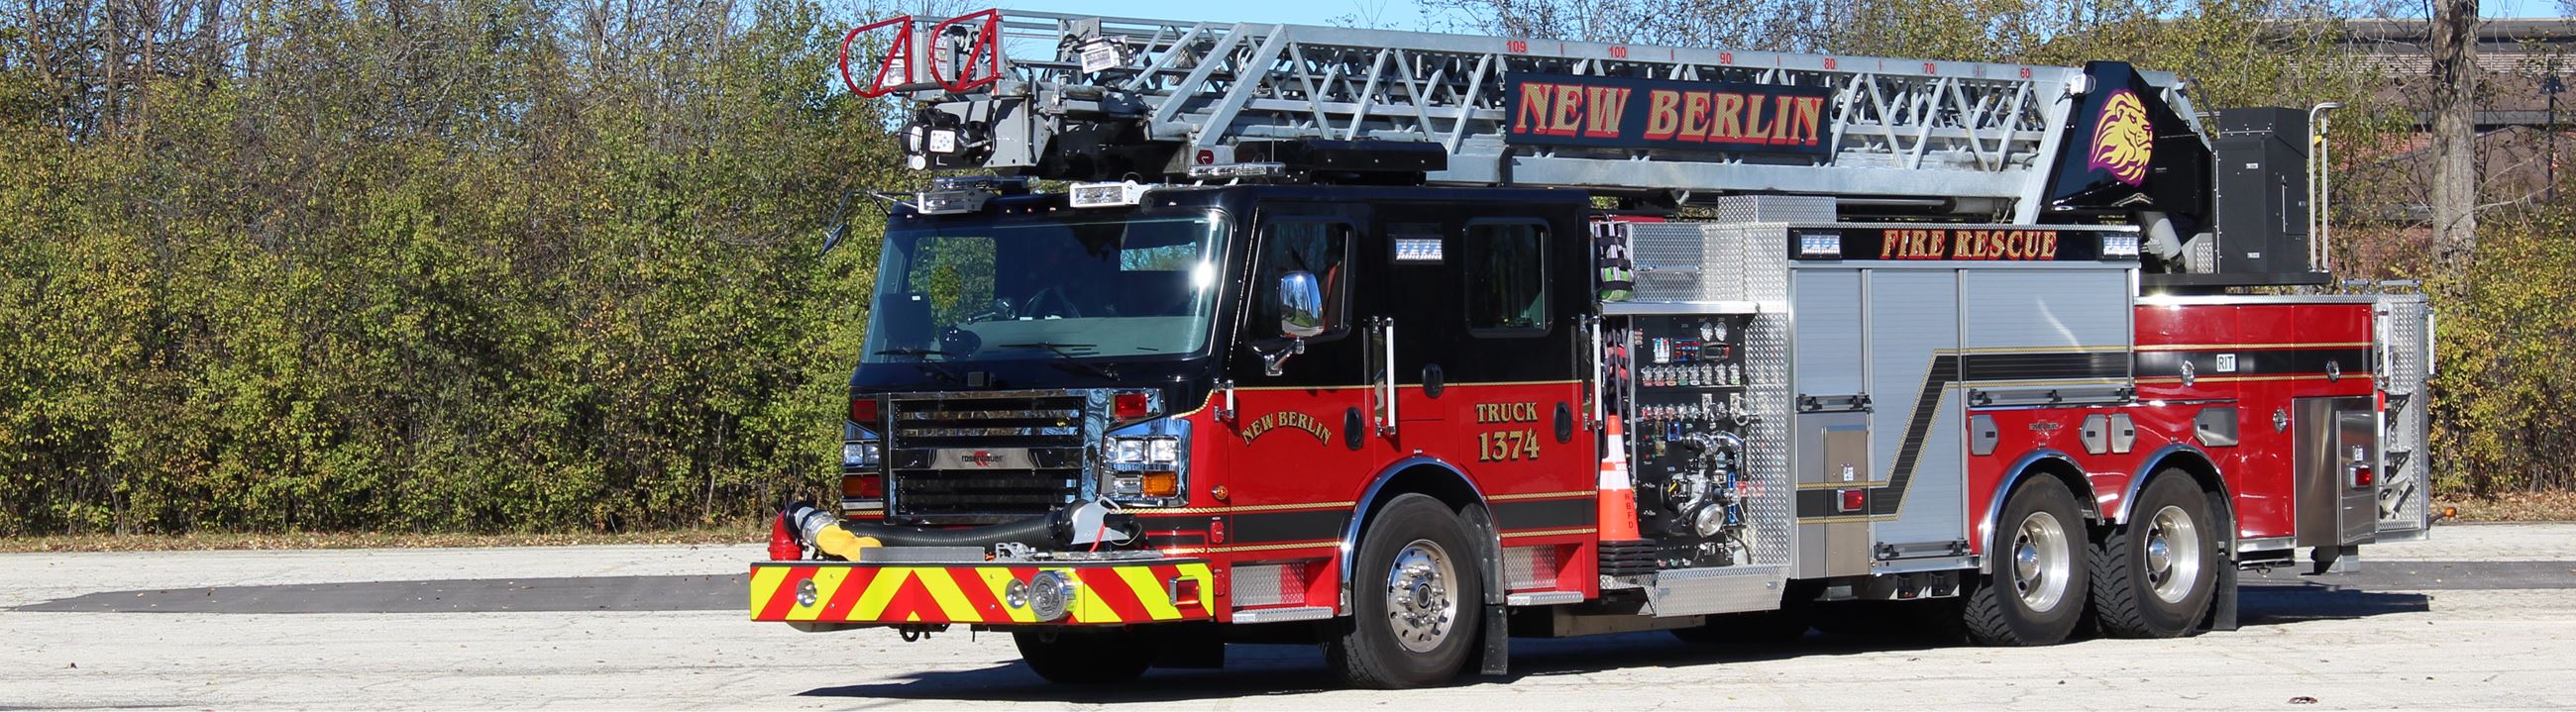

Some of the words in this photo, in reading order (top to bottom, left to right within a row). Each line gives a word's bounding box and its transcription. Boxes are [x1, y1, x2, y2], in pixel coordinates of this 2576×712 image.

[1506, 41, 1527, 52] 109
[1609, 47, 1627, 58] 100
[1720, 52, 1732, 64] 90
[1824, 58, 1836, 69] 80
[1924, 63, 1935, 74] 70
[2020, 67, 2030, 79] 60
[1513, 82, 1631, 138] NEW
[1644, 89, 1824, 146] BERLIN
[1879, 229, 1945, 259] FIRE
[1952, 230, 2057, 260] RESCUE
[2218, 356, 2233, 370] RIT
[1475, 402, 1539, 423] TRUCK
[1242, 413, 1274, 445] NEW
[1278, 411, 1332, 446] BERLIN
[1477, 427, 1540, 460] 1374
